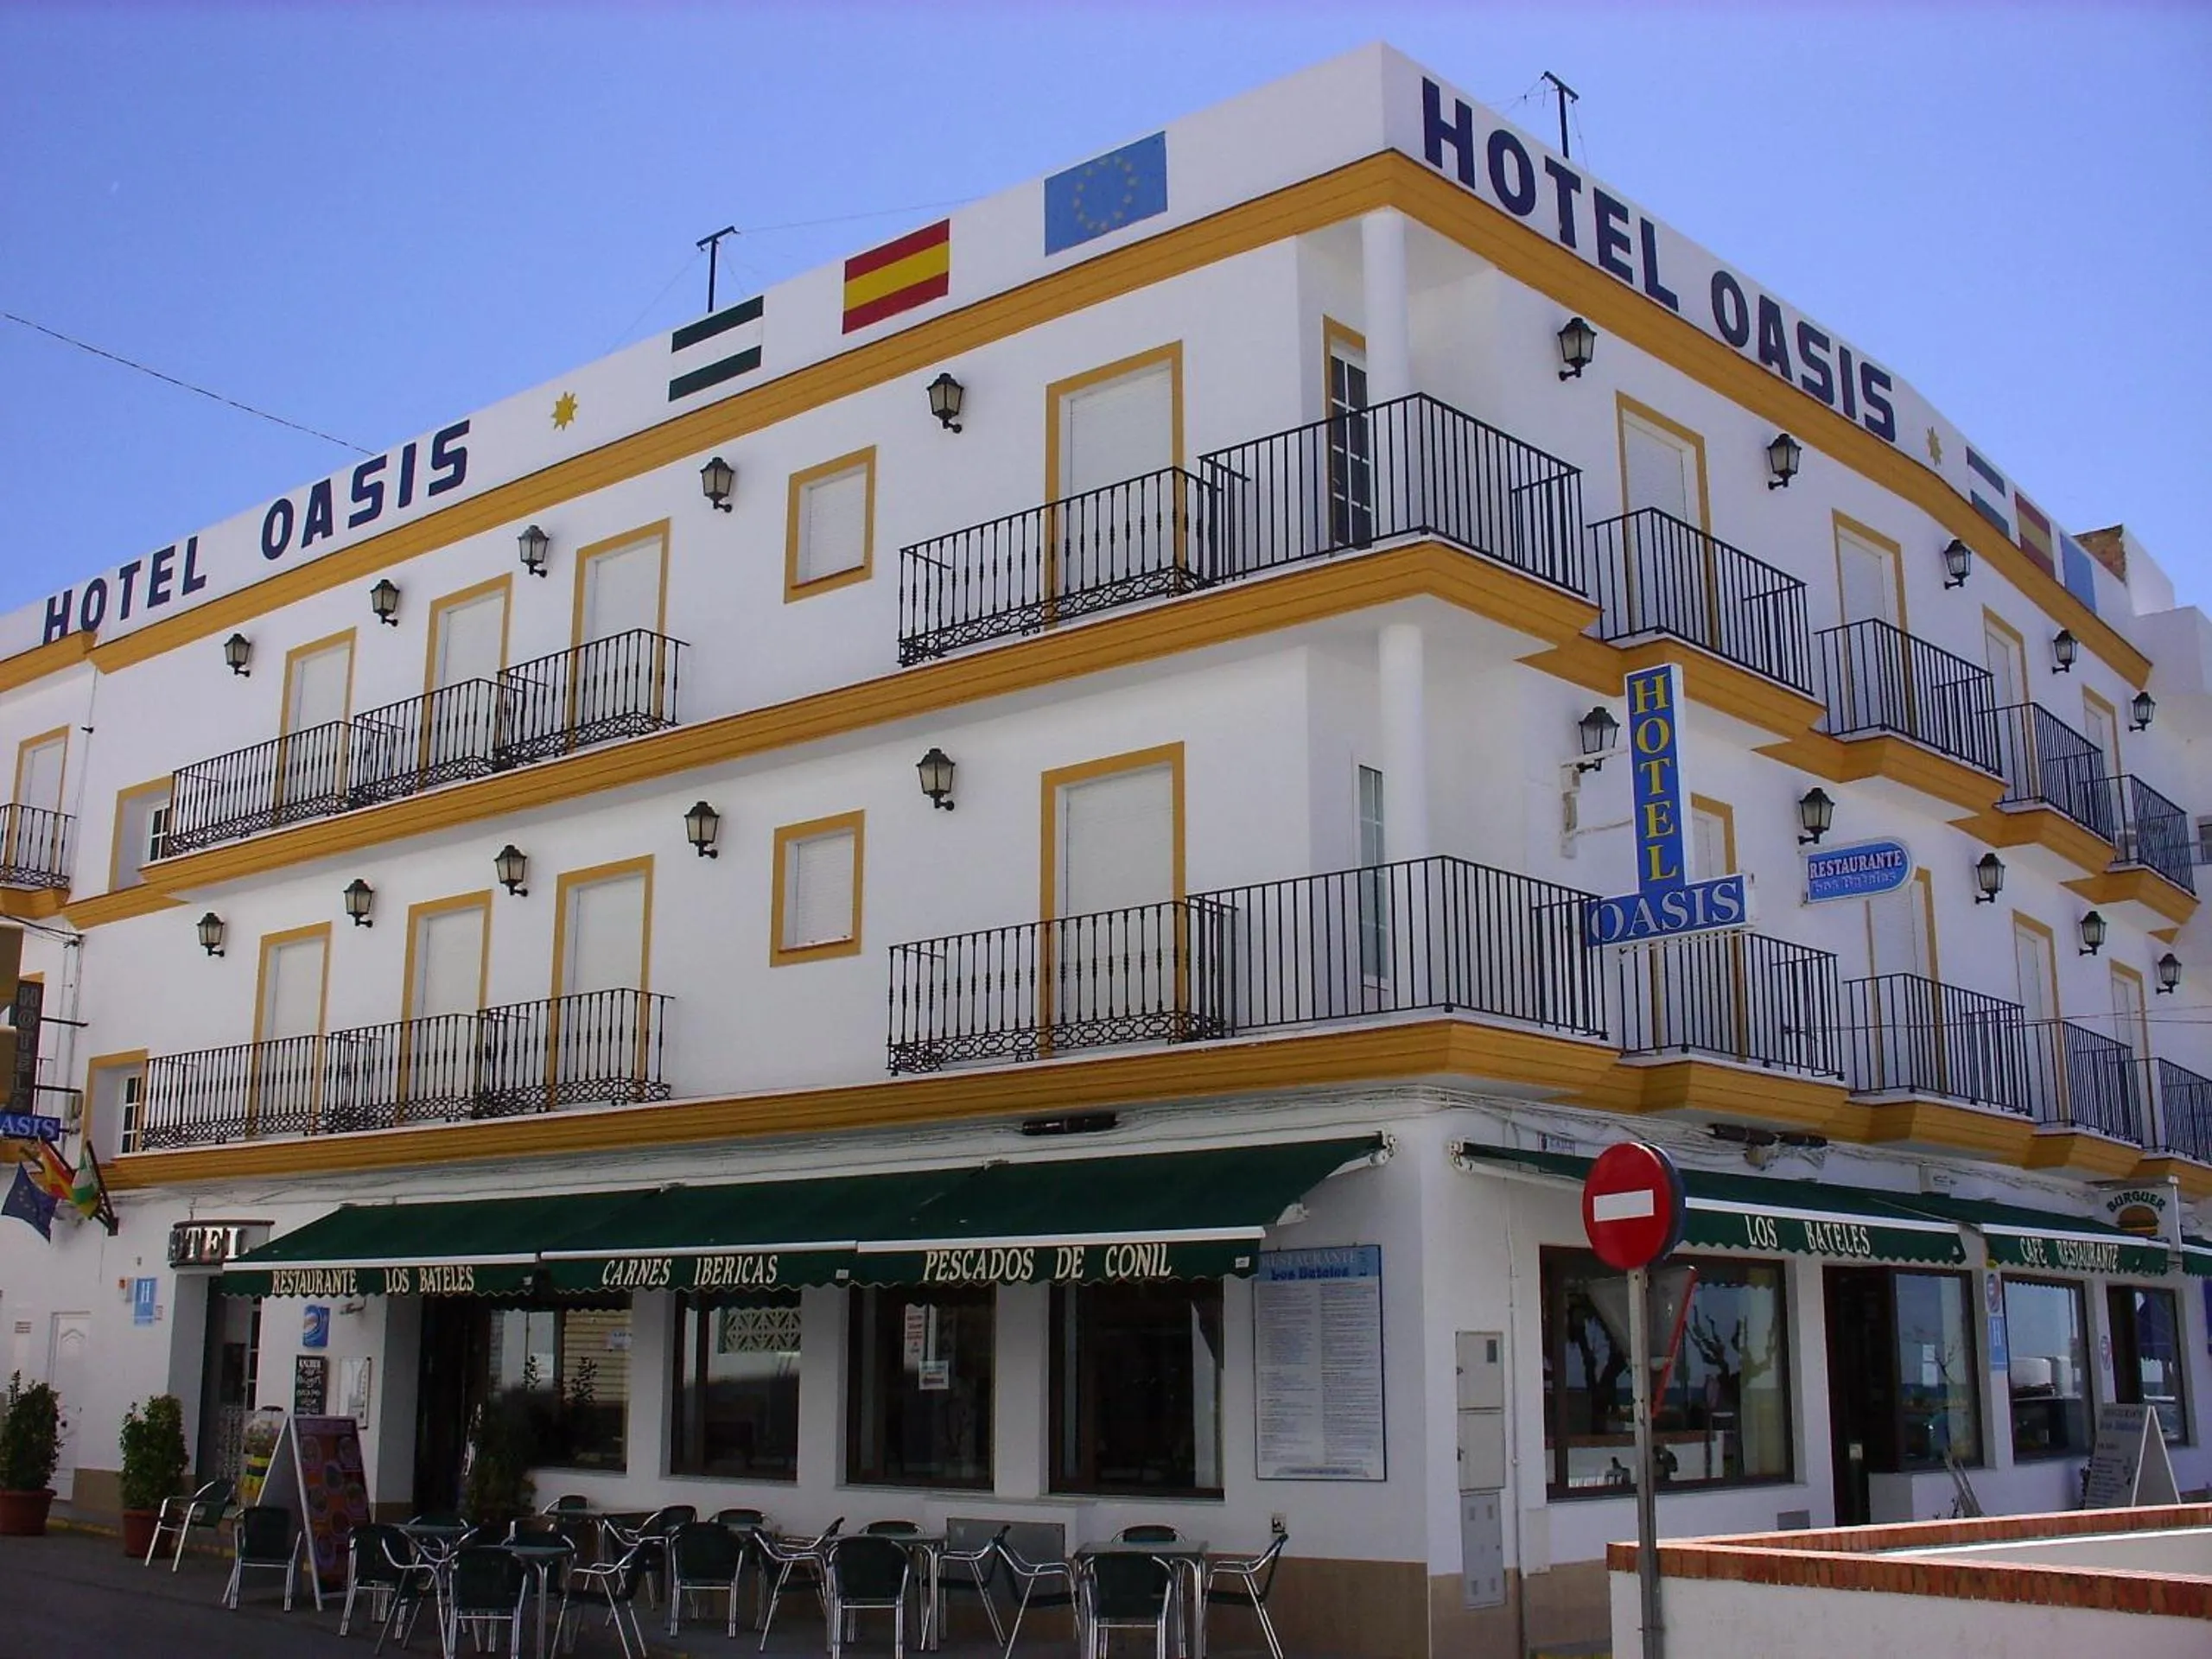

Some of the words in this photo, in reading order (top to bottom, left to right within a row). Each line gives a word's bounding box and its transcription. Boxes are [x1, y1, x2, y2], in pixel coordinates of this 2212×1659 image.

[1422, 77, 1678, 312] HOTEL
[1712, 270, 1896, 442] OASIS
[42, 535, 207, 645] HOTEL
[261, 419, 471, 561] OASIS
[1632, 674, 1677, 881] HOTEL
[1809, 850, 1903, 880] RESTAURANTE
[1591, 882, 1740, 941] OASIS
[0, 1115, 58, 1139] ASIS
[2107, 1191, 2166, 1213] BURGUER
[1745, 1214, 1777, 1249] LOS
[1805, 1221, 1871, 1255] BATELES
[601, 1258, 672, 1287] CARNES
[693, 1255, 778, 1286] IBERICAS
[923, 1248, 1034, 1282] PESCADOS
[1055, 1246, 1085, 1280] DE
[1105, 1243, 1173, 1278] CONIL
[1262, 1251, 1357, 1268] RESTAURANTE
[2019, 1237, 2048, 1265] CAFE
[2056, 1241, 2120, 1271] RESTAURANTE
[272, 1268, 358, 1294] RESTAURANTE
[385, 1268, 410, 1294] LOS
[419, 1265, 474, 1293] BATELES
